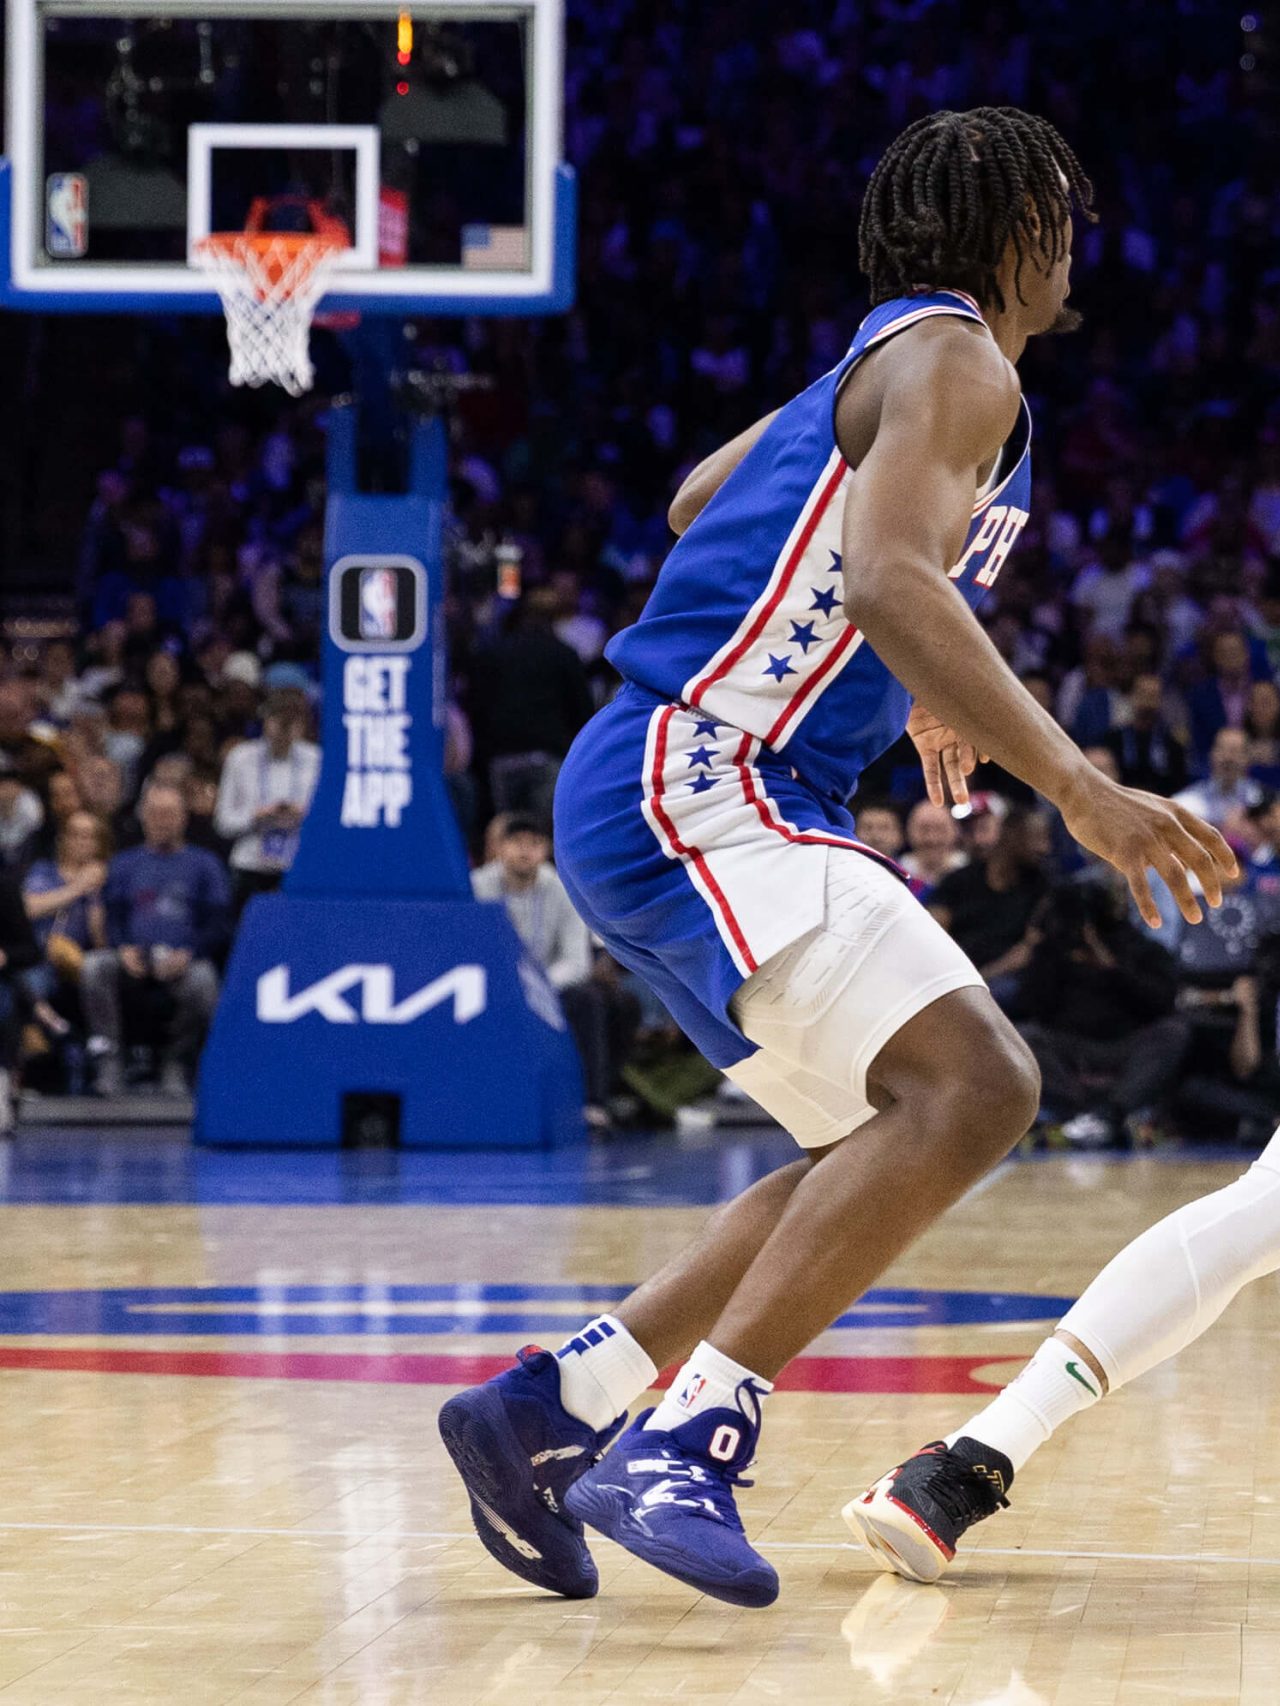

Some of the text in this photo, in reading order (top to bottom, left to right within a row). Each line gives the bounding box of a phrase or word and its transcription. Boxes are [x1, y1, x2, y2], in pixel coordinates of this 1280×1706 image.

[343, 655, 412, 711] GET
[342, 713, 413, 768] THE
[340, 771, 413, 828] APP
[709, 1424, 741, 1462] 0
